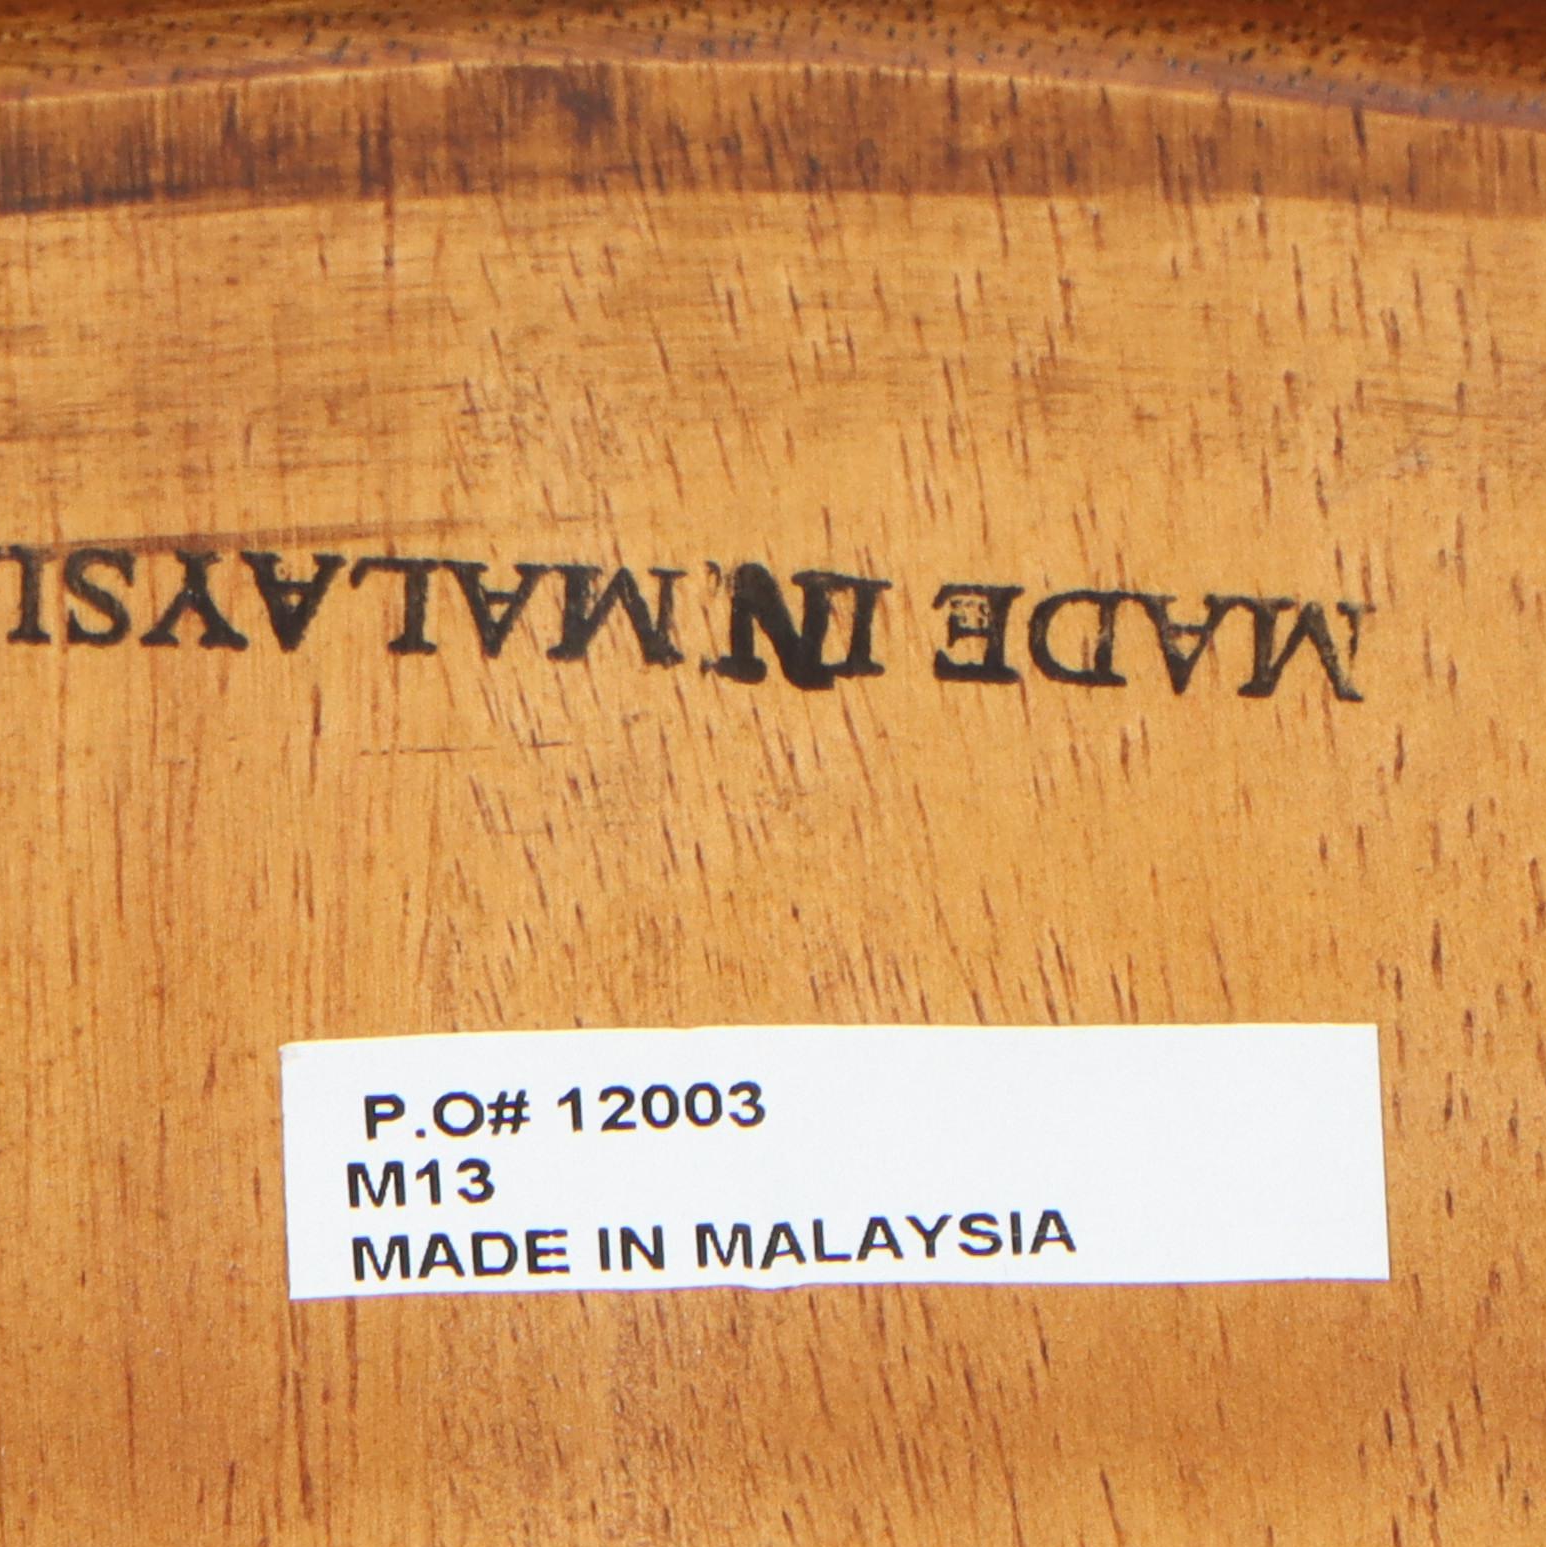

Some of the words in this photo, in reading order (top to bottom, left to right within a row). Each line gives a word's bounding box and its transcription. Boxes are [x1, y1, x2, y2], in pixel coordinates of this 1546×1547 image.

[699, 562, 893, 689] IN
[933, 582, 1376, 702] MADE
[364, 1091, 530, 1141] P.O#
[557, 1081, 767, 1133] 12003
[345, 1157, 497, 1208] M13
[351, 1229, 571, 1282] MADE
[599, 1225, 665, 1275] IN
[695, 1208, 1076, 1270] MALAYSIA
